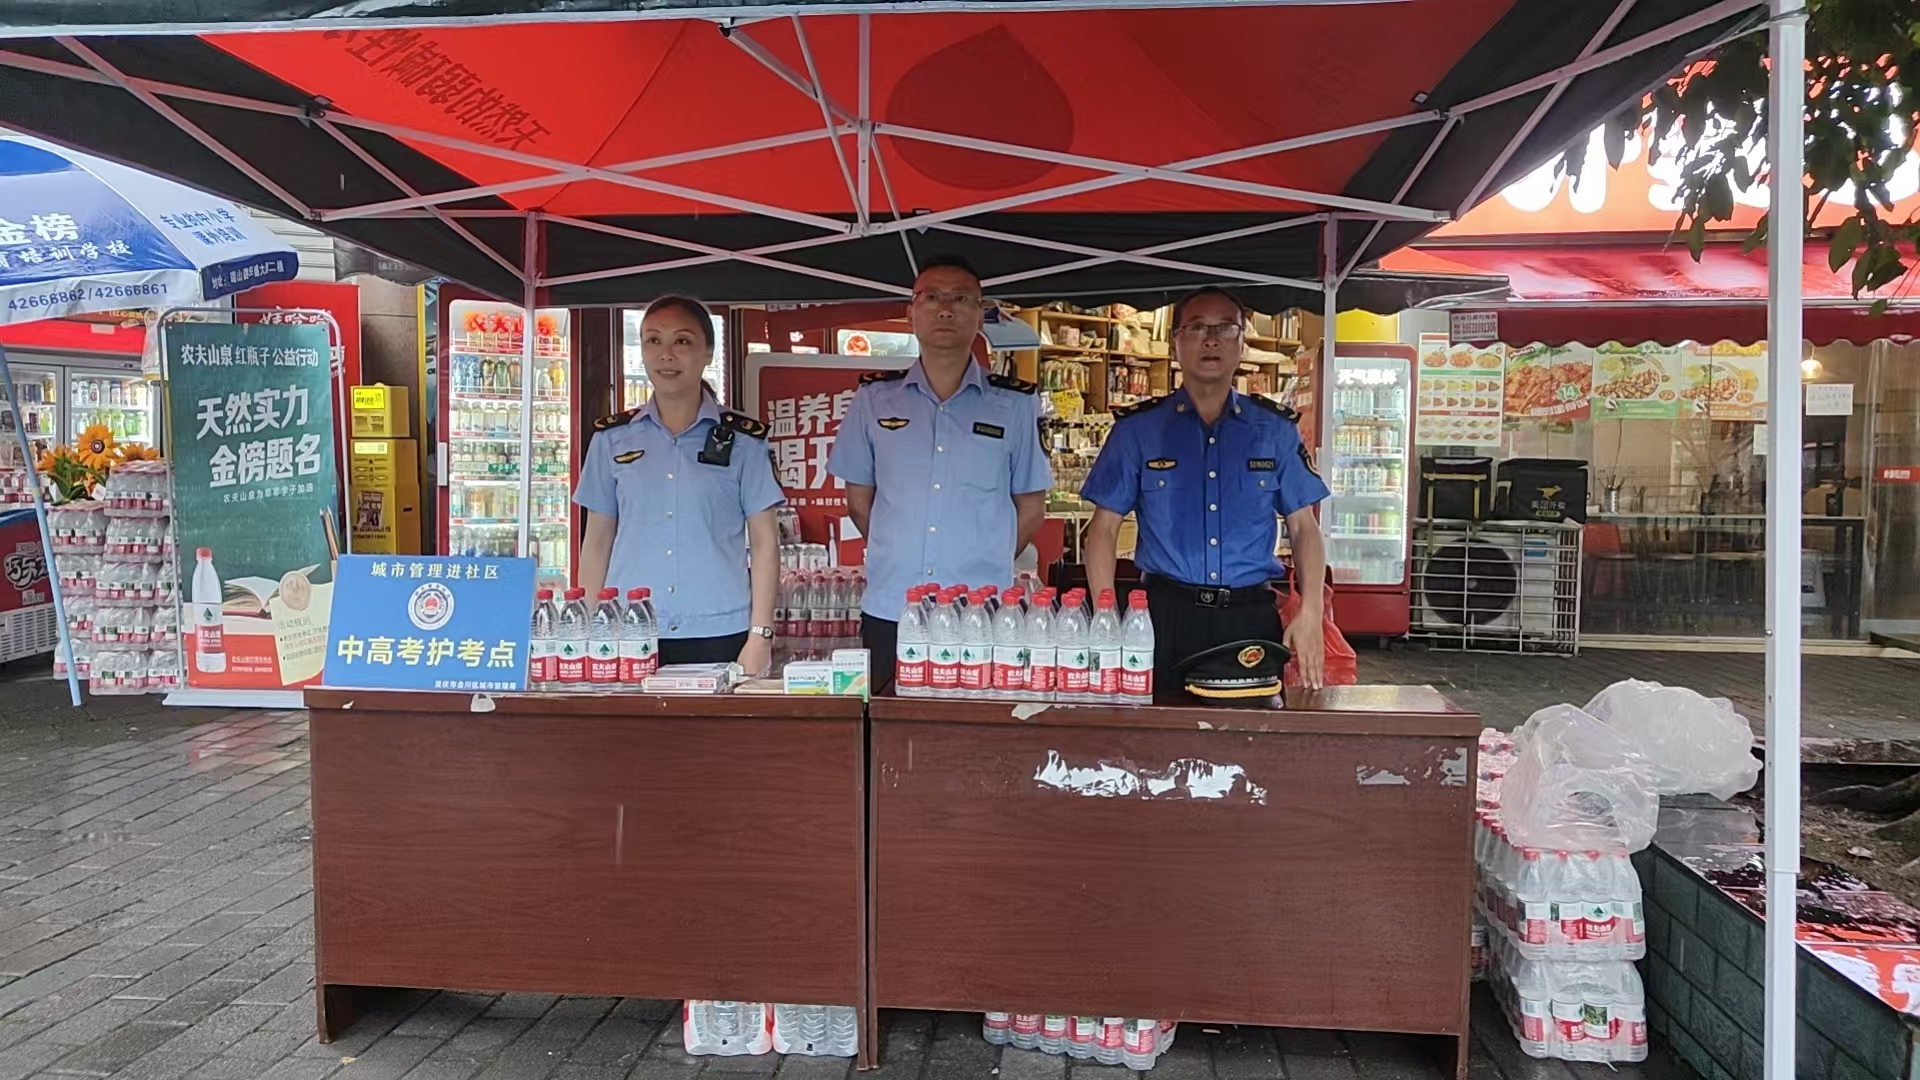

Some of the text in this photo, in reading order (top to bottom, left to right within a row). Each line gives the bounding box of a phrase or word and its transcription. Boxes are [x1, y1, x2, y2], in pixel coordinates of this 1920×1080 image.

[8, 283, 168, 311] 42666862/42666861
[181, 344, 233, 366] 农夫山泉
[235, 346, 271, 367] 红瓶子
[273, 347, 319, 367] 公益行动
[196, 384, 309, 441] 天然实力
[209, 433, 321, 488] 金榜题名
[371, 561, 499, 580] 城市管理进社区
[337, 634, 517, 669] 中高考护考点
